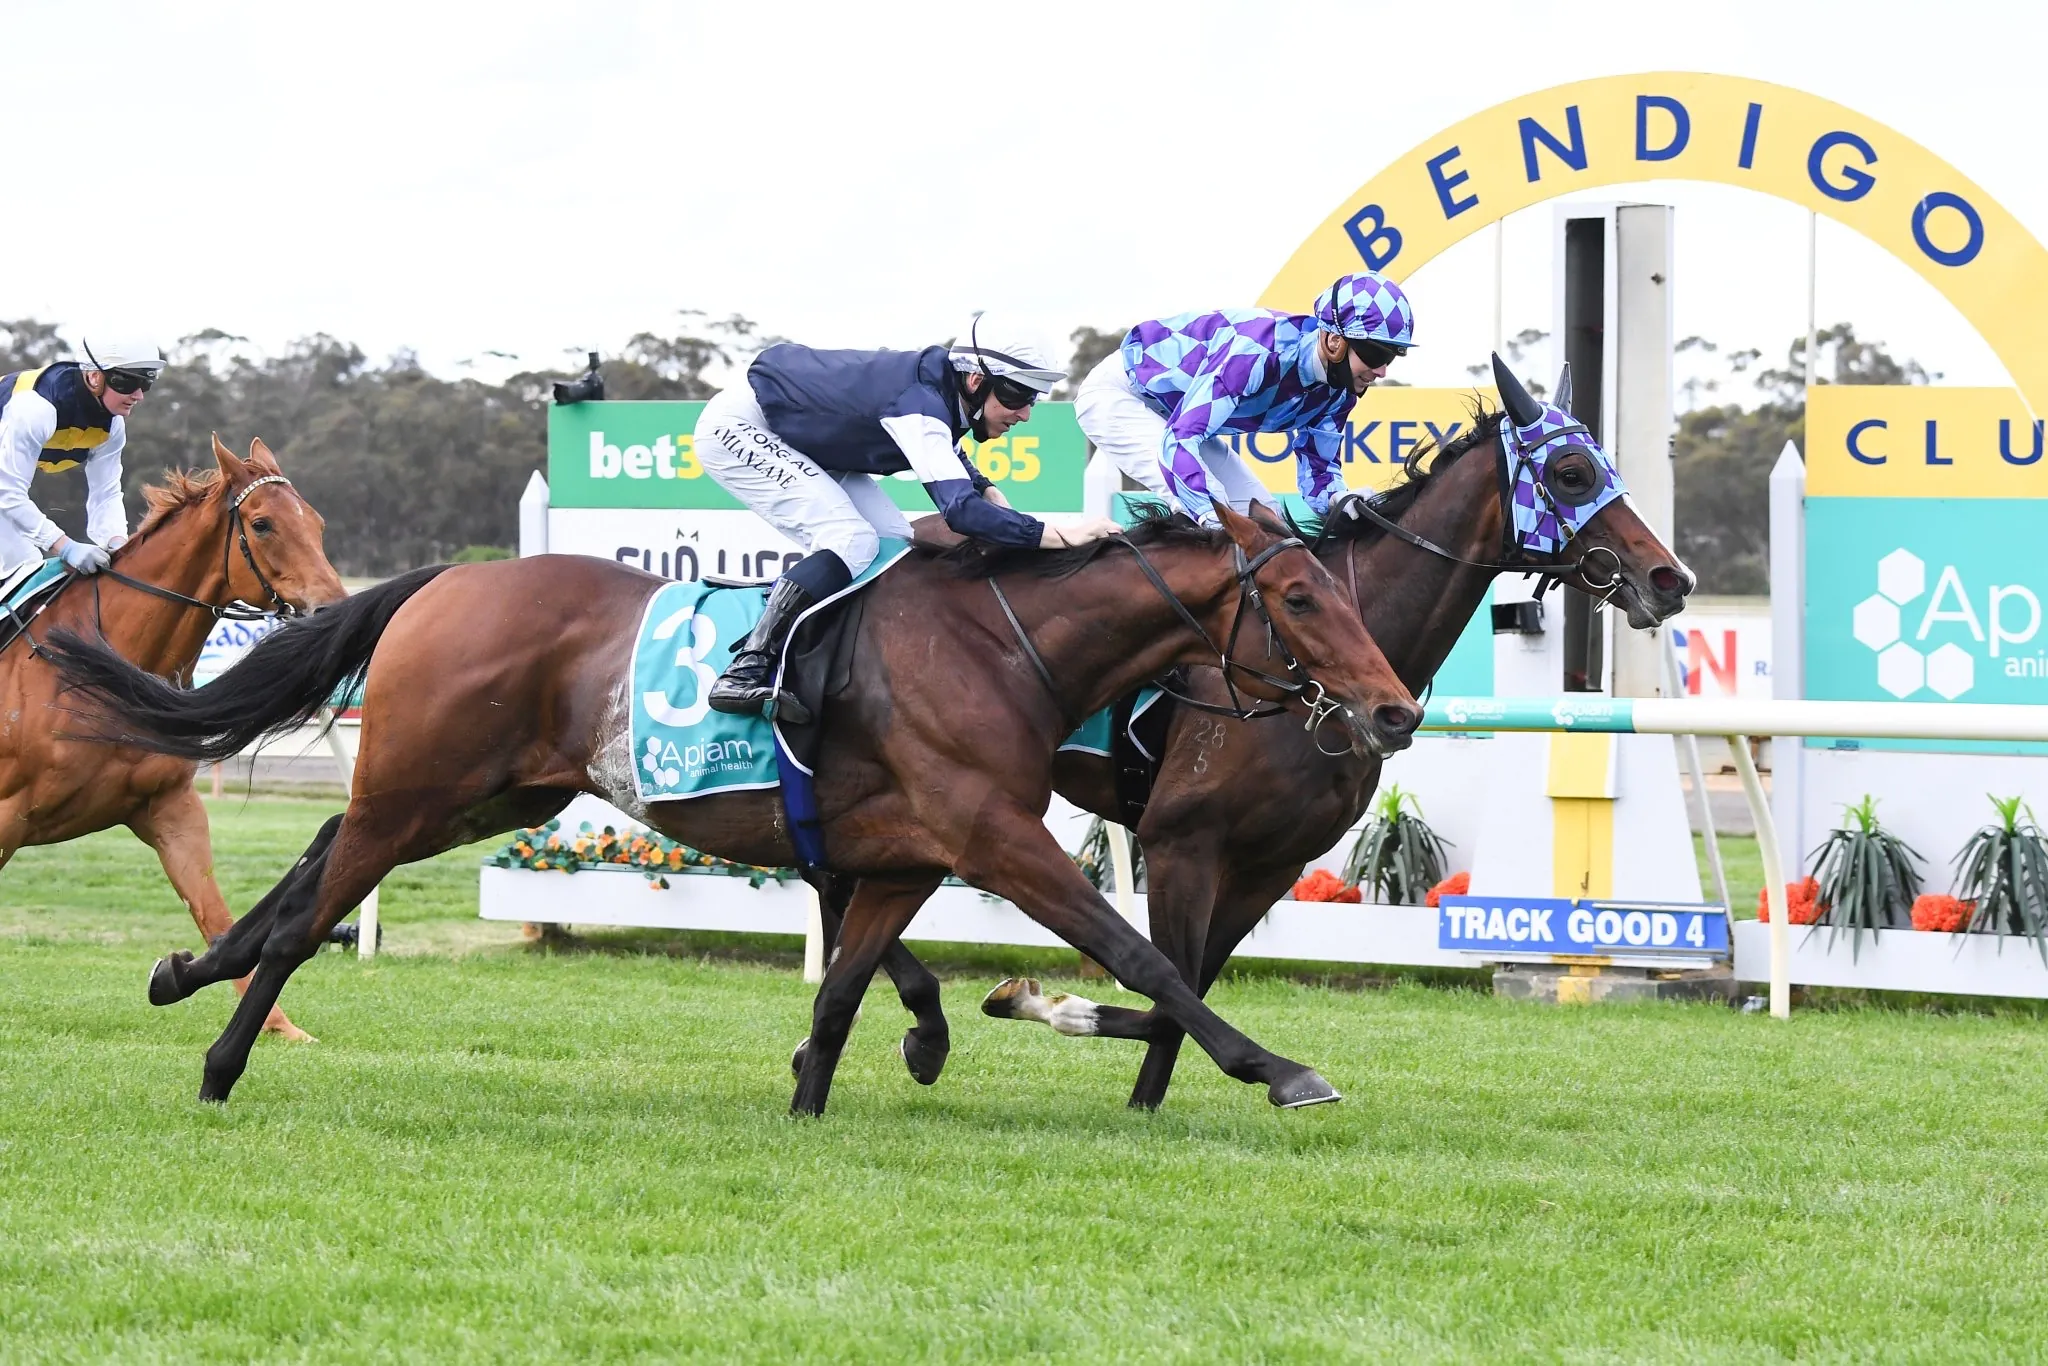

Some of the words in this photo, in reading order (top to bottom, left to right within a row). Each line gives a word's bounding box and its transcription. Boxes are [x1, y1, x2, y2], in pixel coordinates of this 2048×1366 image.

[1343, 95, 1985, 271] BENDIGO
[1915, 565, 2042, 658] Ap
[643, 605, 719, 727] 3
[660, 738, 753, 772] Apiam
[689, 763, 719, 778] animal
[721, 760, 753, 772] health
[1446, 906, 1555, 942] TRACK
[1567, 909, 1678, 946] GOOD
[1685, 915, 1705, 947] 4
